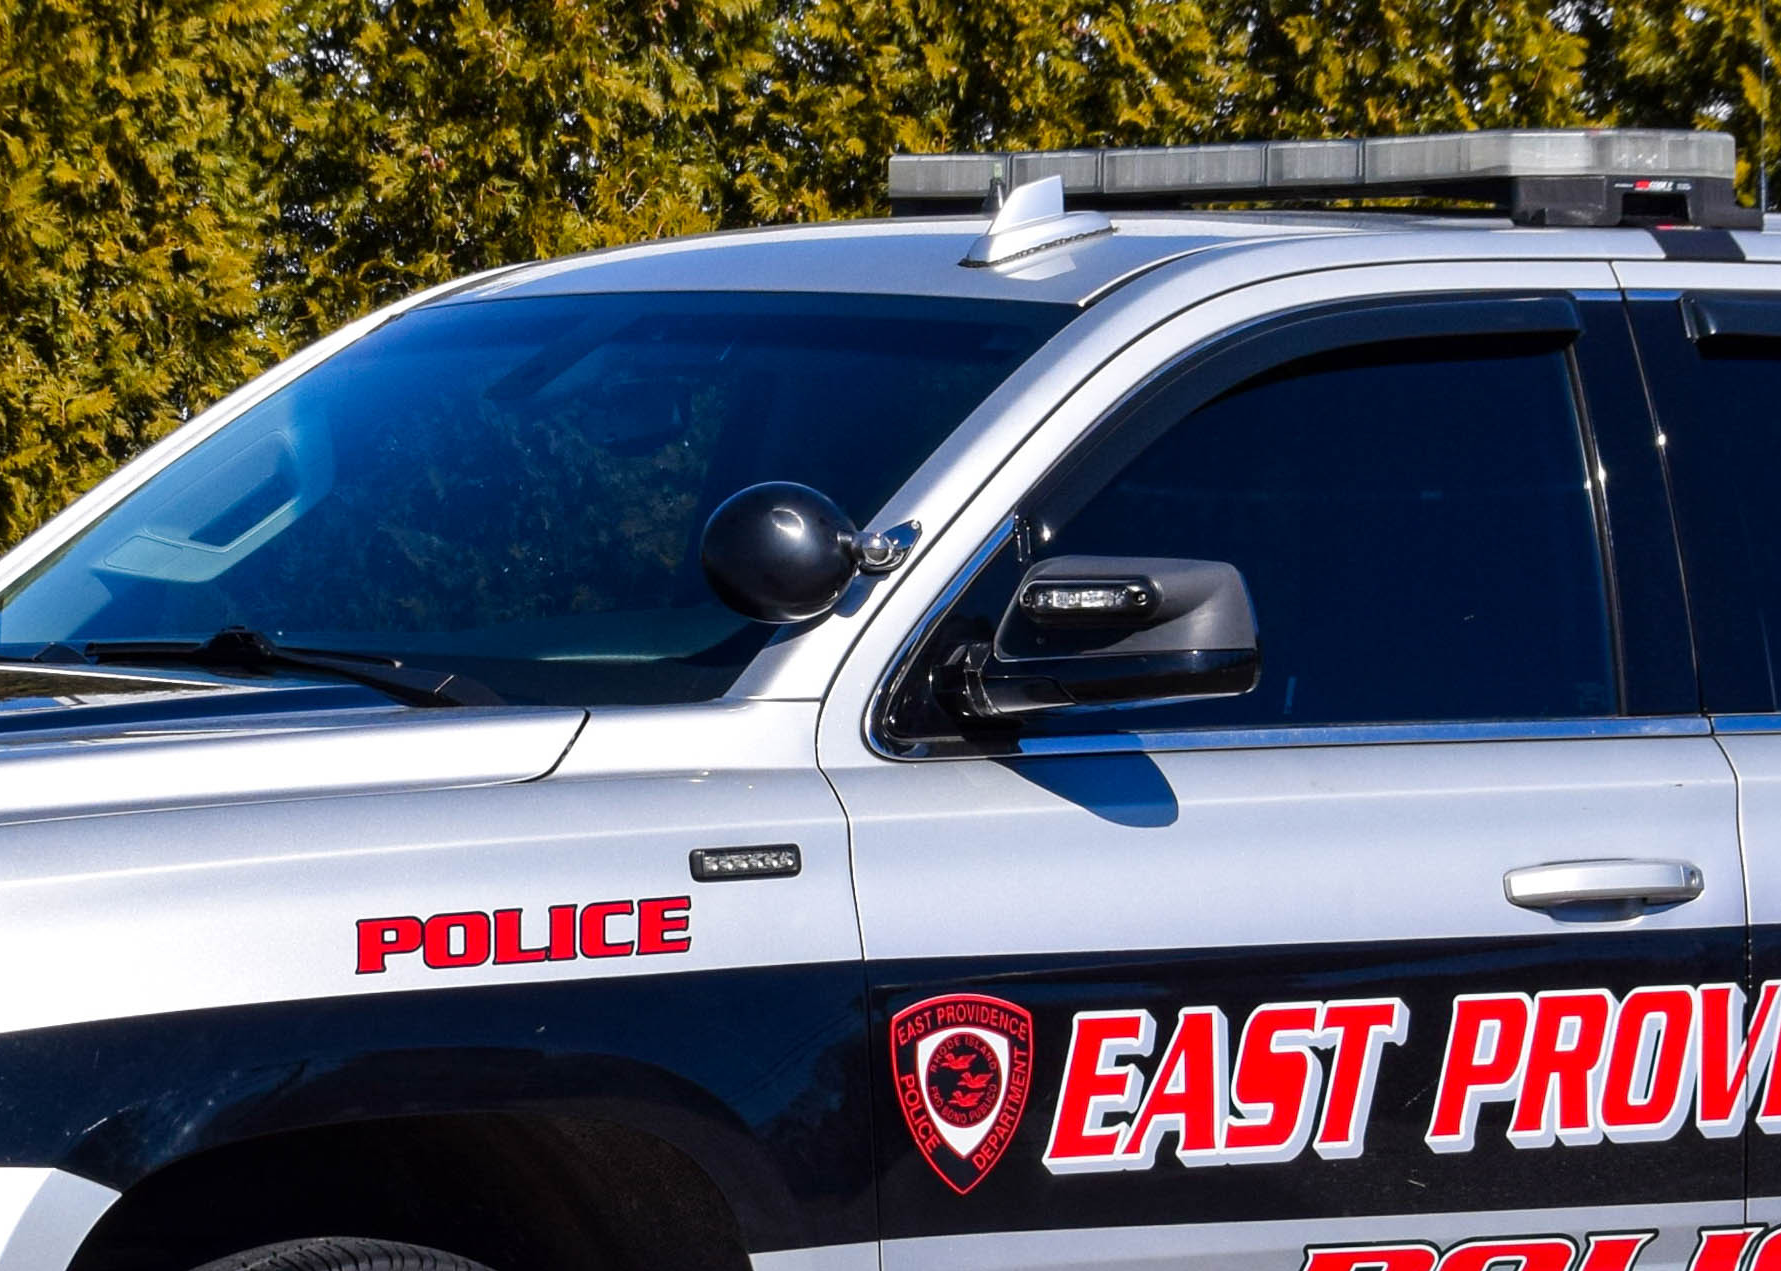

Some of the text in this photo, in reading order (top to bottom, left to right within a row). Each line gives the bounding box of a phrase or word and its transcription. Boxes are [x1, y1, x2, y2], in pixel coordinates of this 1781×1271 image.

[355, 895, 692, 974] POLICE
[897, 1004, 1029, 1046] EAST PROVIDENCE
[930, 1036, 997, 1072] RHODE ISLAND
[900, 1046, 1028, 1171] POLICE DEPARTMENT
[1041, 996, 1411, 1176] EAST
